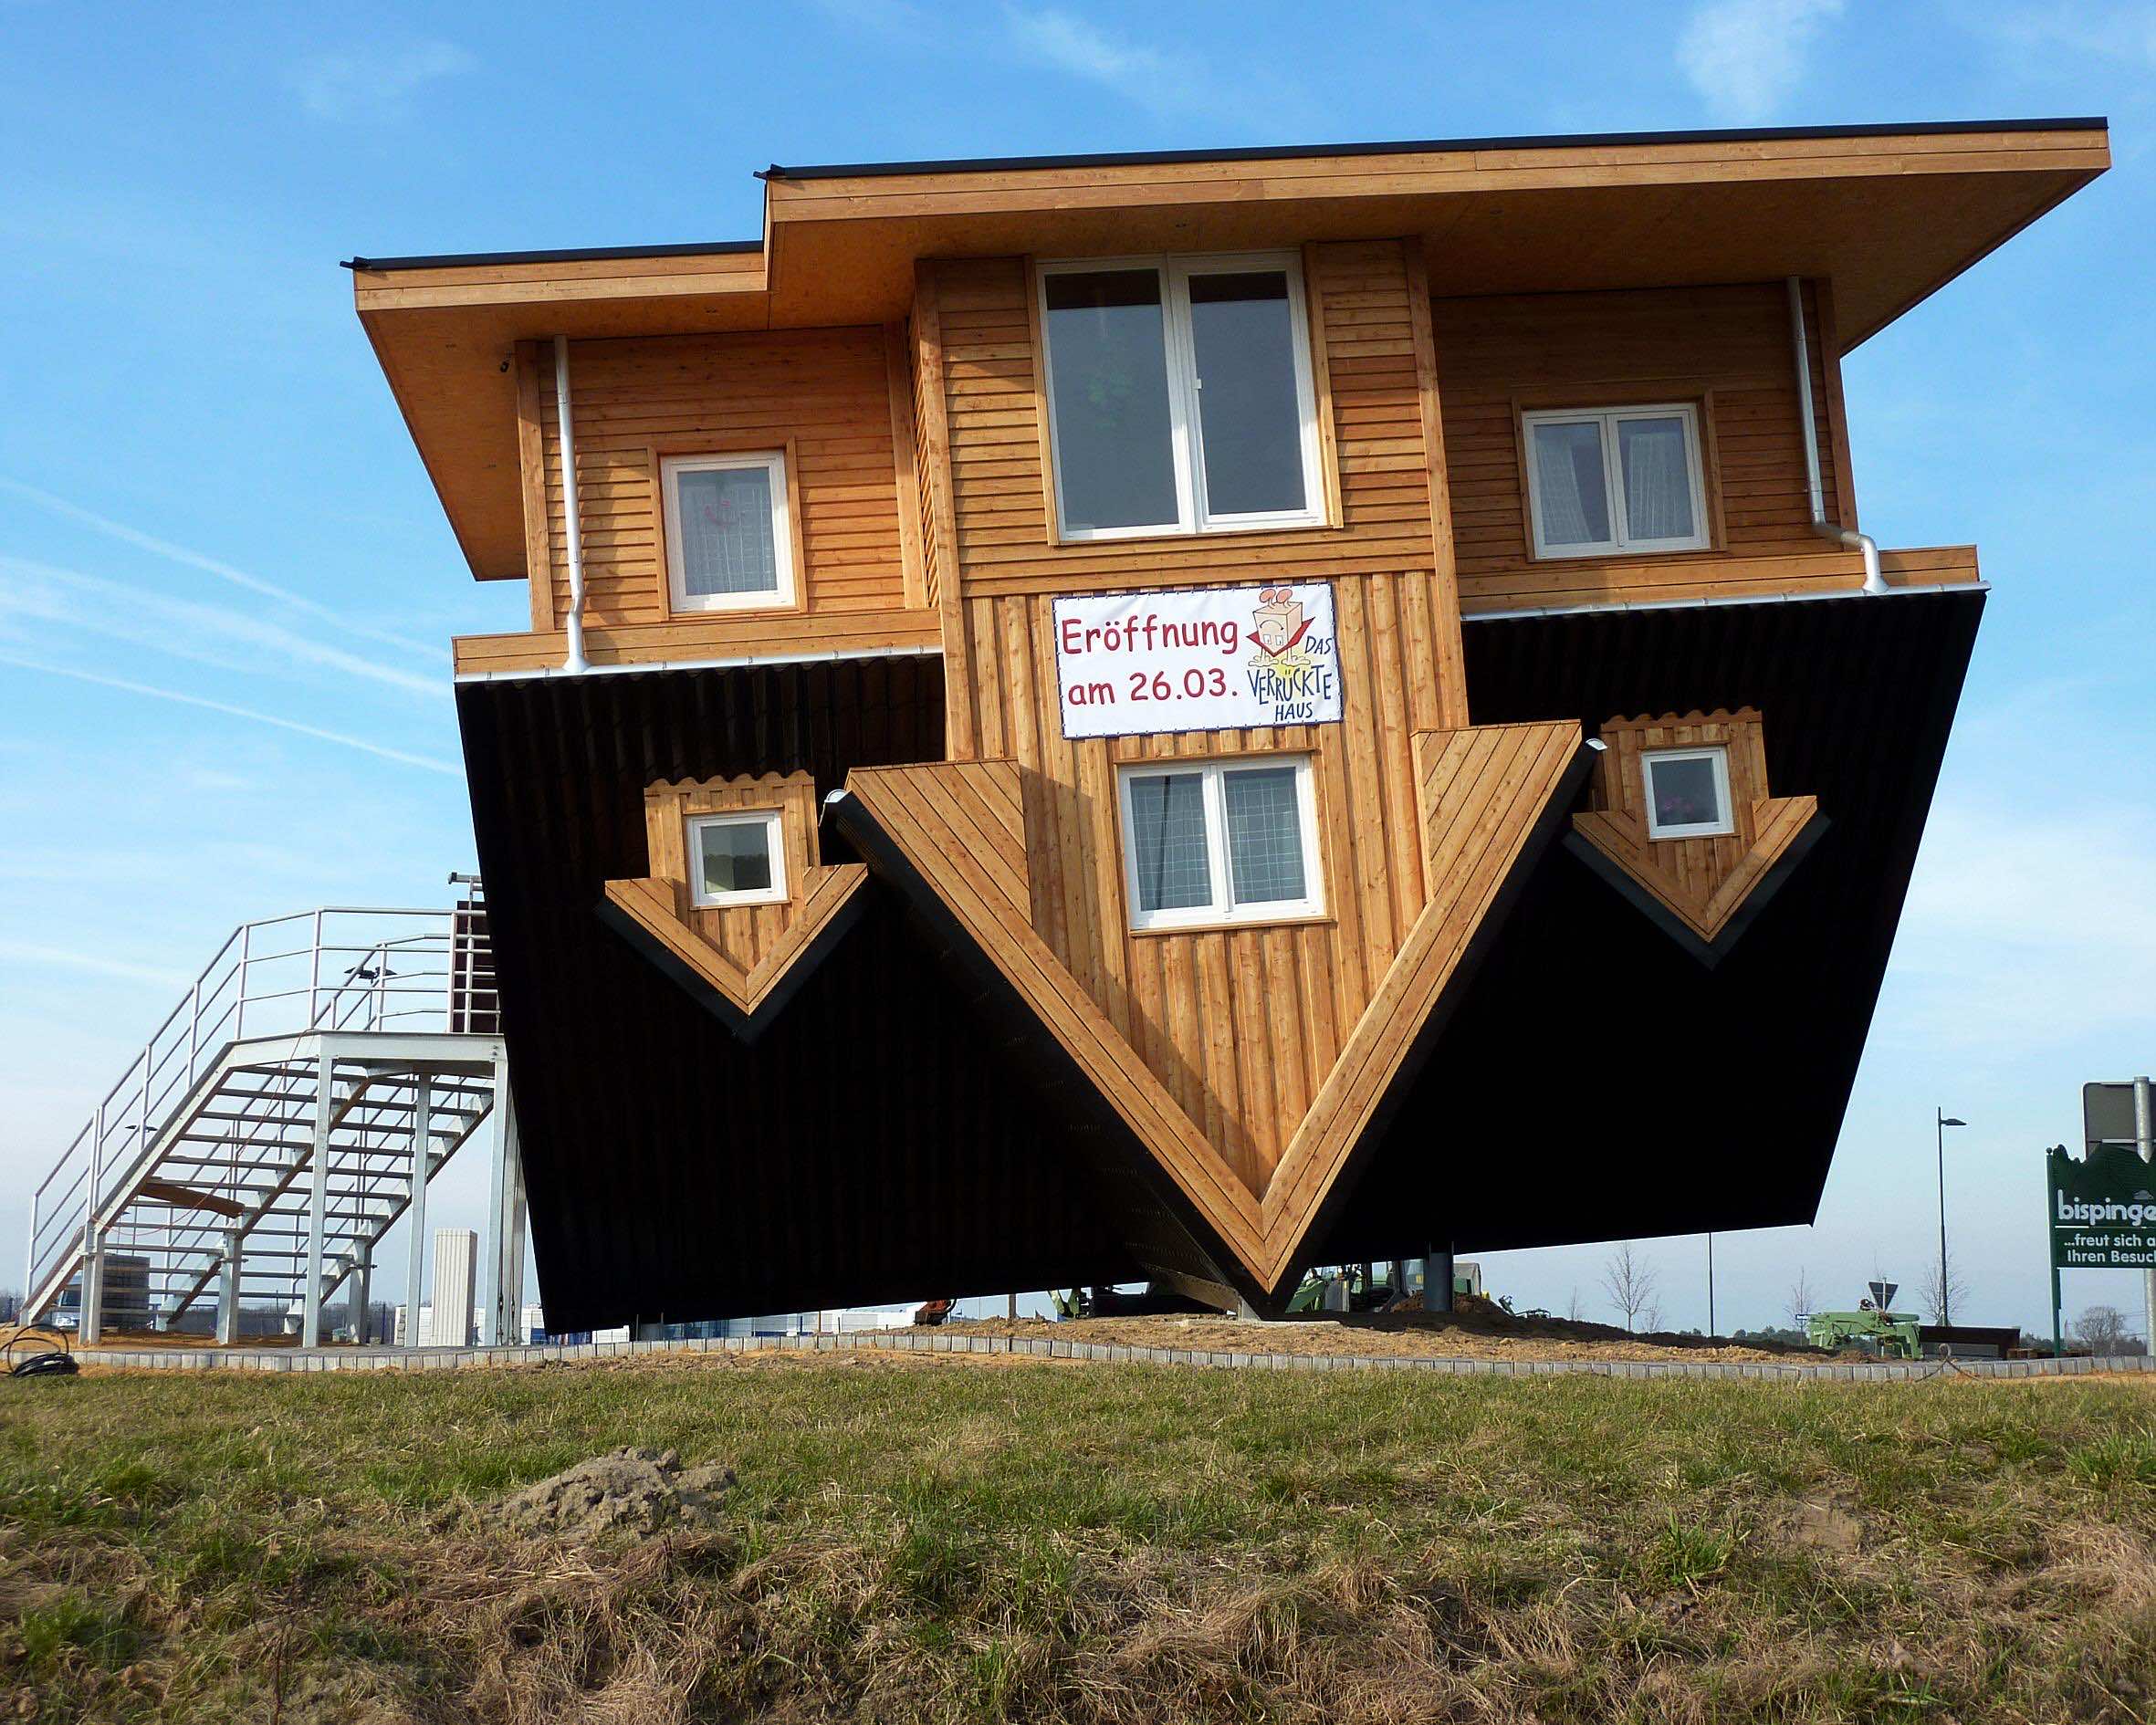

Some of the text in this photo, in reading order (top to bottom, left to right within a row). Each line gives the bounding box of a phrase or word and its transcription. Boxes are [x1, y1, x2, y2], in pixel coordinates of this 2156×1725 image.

[1062, 613, 1239, 654] Eröffnung
[1304, 635, 1332, 654] DAS
[1068, 667, 1238, 706] am 26.03.
[1247, 664, 1333, 705] VERRÜCKTE
[1275, 702, 1313, 722] HAUS
[2064, 1234, 2109, 1247] ...freut
[2114, 1234, 2141, 1247] sich
[2067, 1249, 2156, 1262] Ihren Besuc
